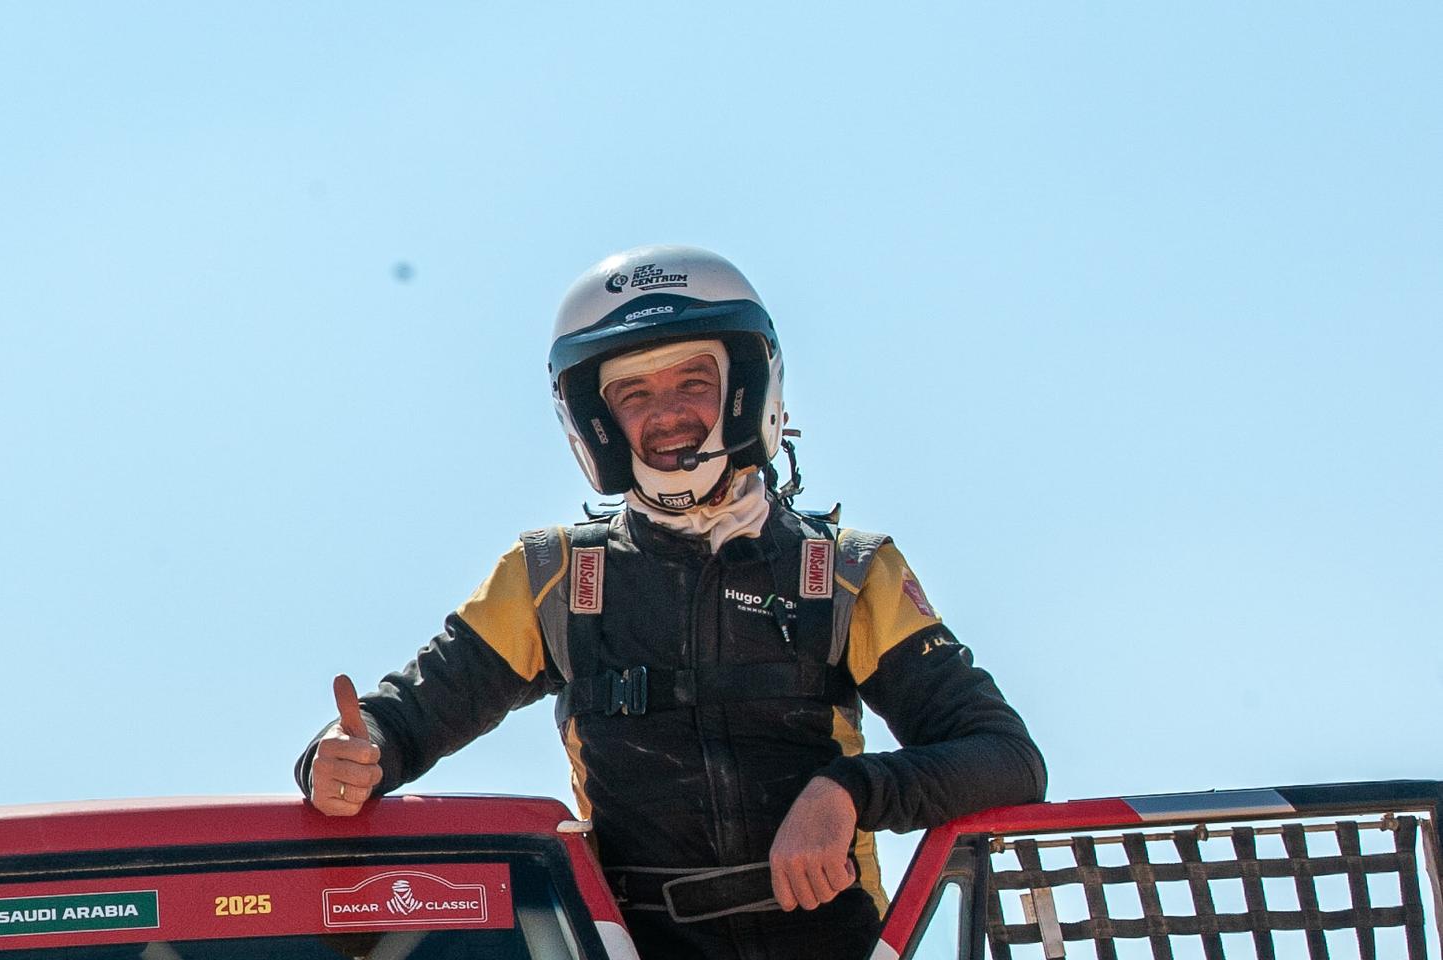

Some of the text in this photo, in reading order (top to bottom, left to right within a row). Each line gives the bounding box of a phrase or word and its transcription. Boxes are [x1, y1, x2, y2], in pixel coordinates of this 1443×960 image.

[631, 274, 688, 287] CENTRUM
[625, 306, 674, 322] sparco
[663, 497, 692, 506] OMP
[809, 545, 825, 592] SIMPSON
[578, 554, 595, 607] SIMPSON
[725, 589, 762, 604] Hugo
[62, 902, 138, 921] ARABIA
[215, 894, 272, 916] 2025
[332, 899, 479, 915] DAKAR CLASSIC
